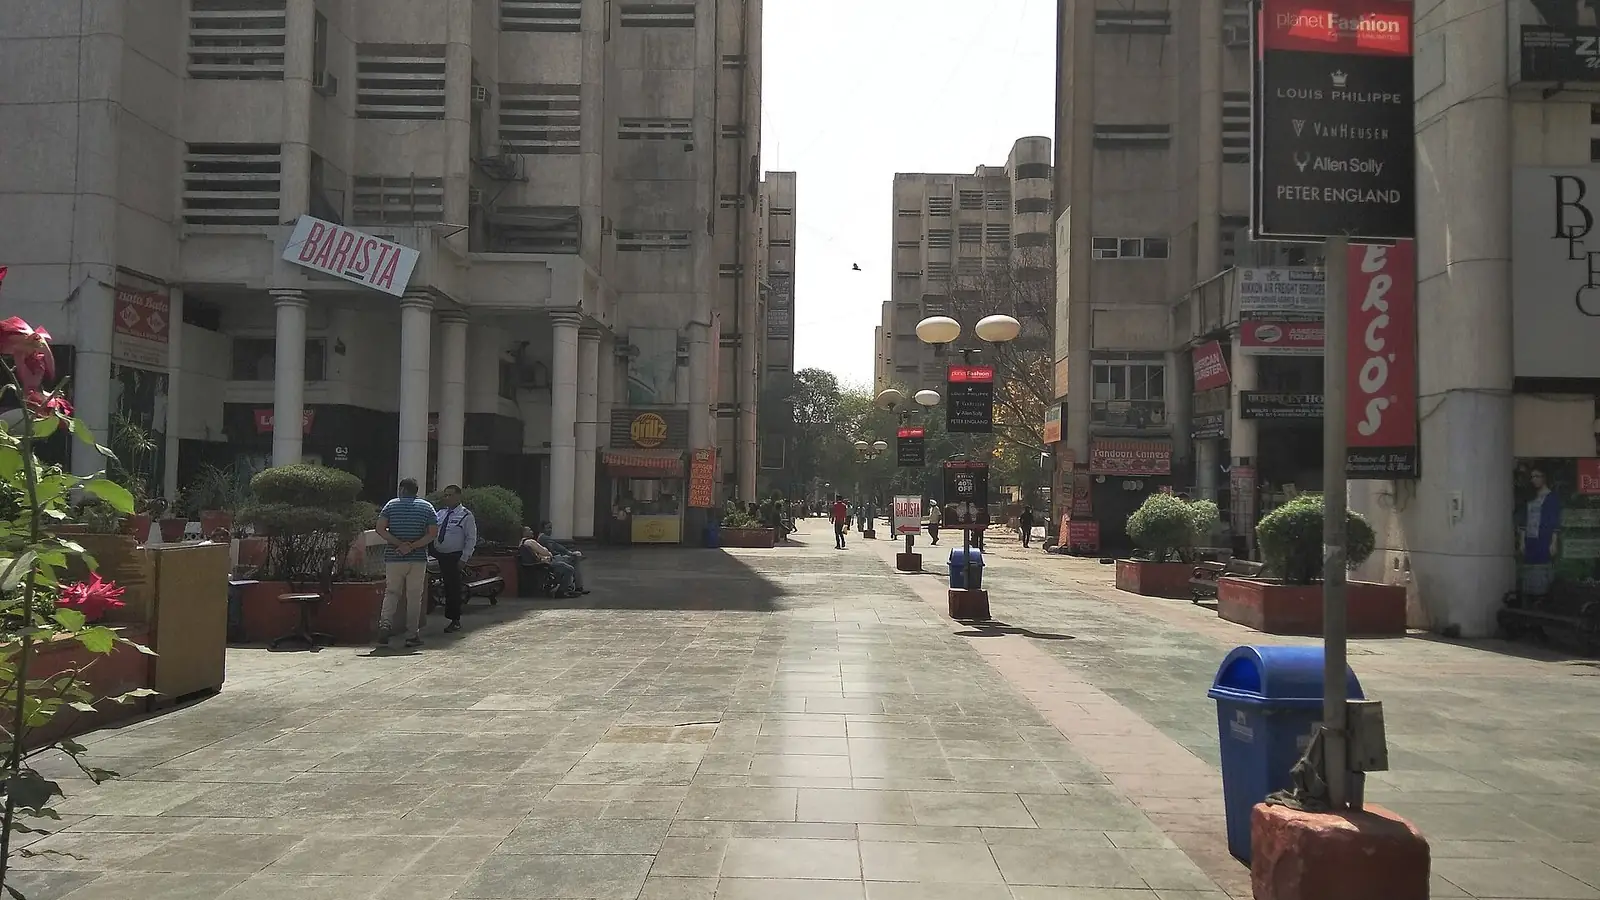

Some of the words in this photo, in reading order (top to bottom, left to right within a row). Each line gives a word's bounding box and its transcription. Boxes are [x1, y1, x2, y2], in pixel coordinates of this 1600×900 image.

[1276, 12, 1325, 28] planet
[1327, 12, 1400, 32] Fashion
[1276, 88, 1324, 99] LOUIS
[1331, 91, 1401, 104] PHILIPPE
[1312, 155, 1348, 173] Allen
[1349, 157, 1384, 176] Solly
[1276, 185, 1321, 201] PETER
[1323, 187, 1401, 204] ENGLAND
[298, 221, 402, 290] BARISTA
[1094, 449, 1133, 458] Tandoori
[1135, 451, 1170, 459] Chinese
[895, 502, 920, 518] BARISTA
